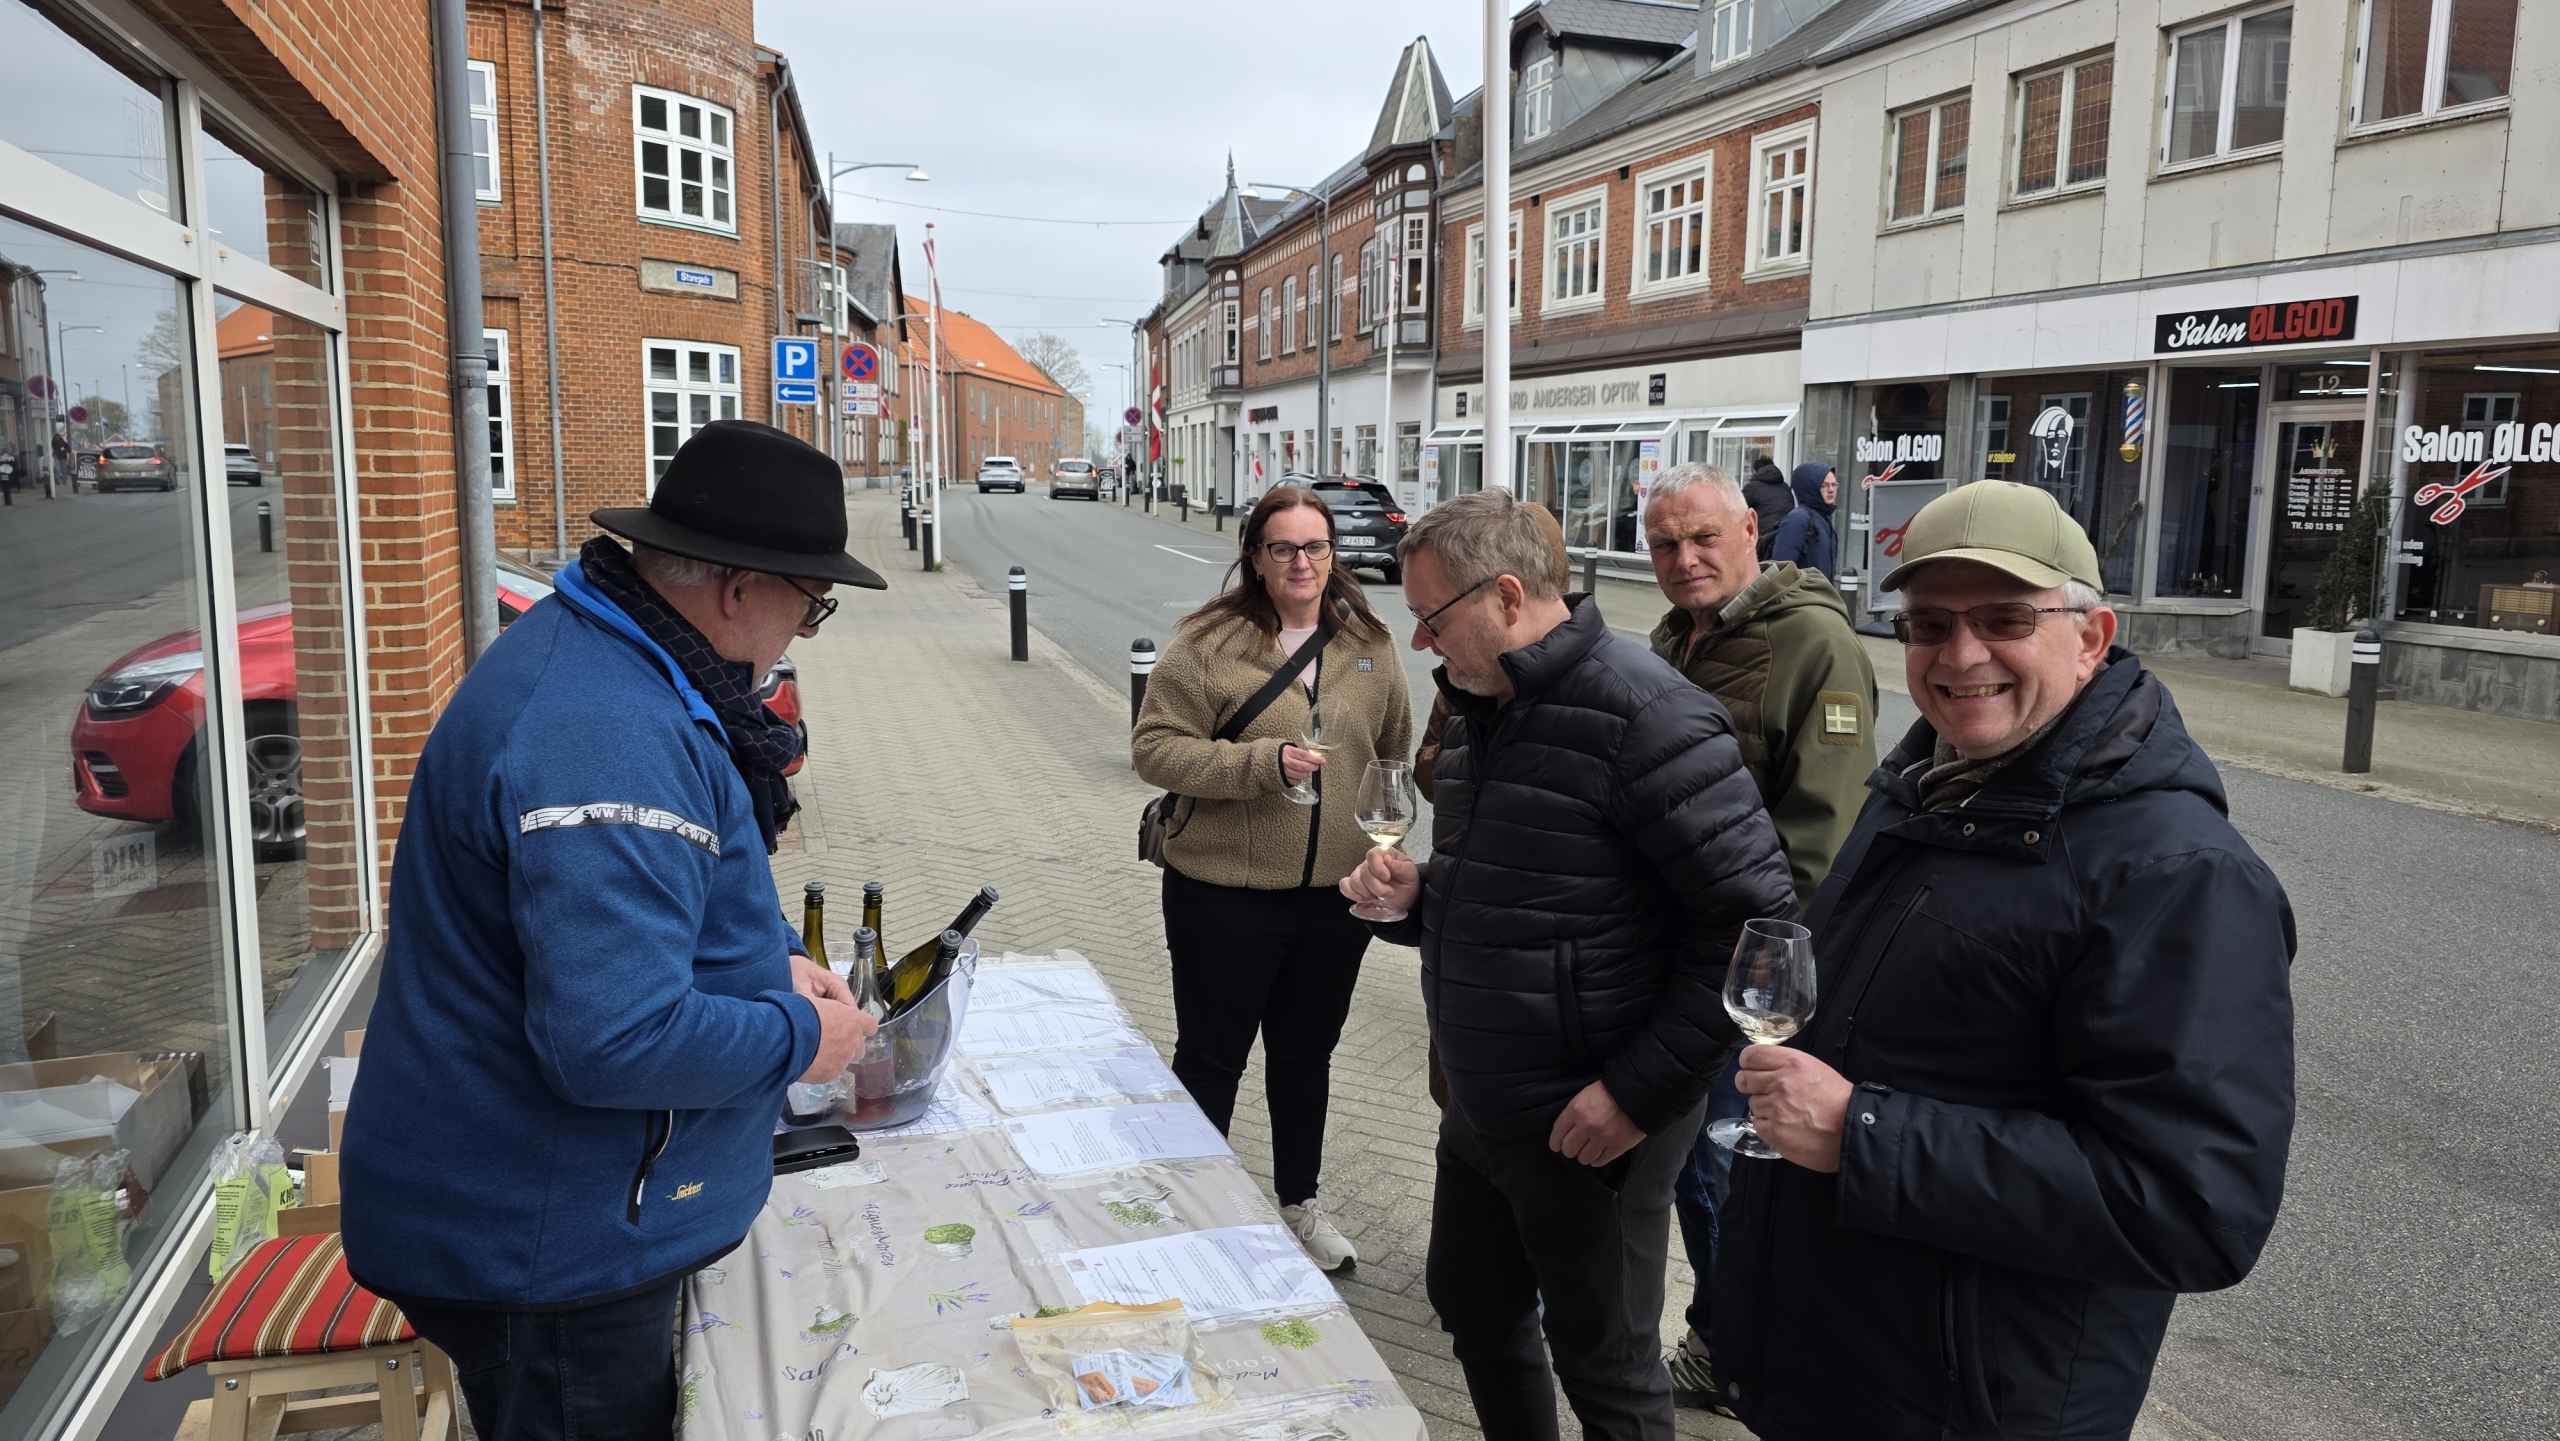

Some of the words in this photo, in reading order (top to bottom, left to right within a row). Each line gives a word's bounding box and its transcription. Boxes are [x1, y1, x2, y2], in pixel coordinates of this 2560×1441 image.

[2167, 314, 2247, 348] Salon
[2249, 298, 2345, 342] ØLGOD
[785, 344, 808, 376] P
[1533, 384, 1596, 409] ANDERSEN
[1601, 381, 1640, 405] OPTIK
[2317, 375, 2341, 395] 12
[1856, 436, 1894, 462] Salon
[1895, 433, 1943, 463] ØLGOD
[2402, 424, 2484, 463] Salon
